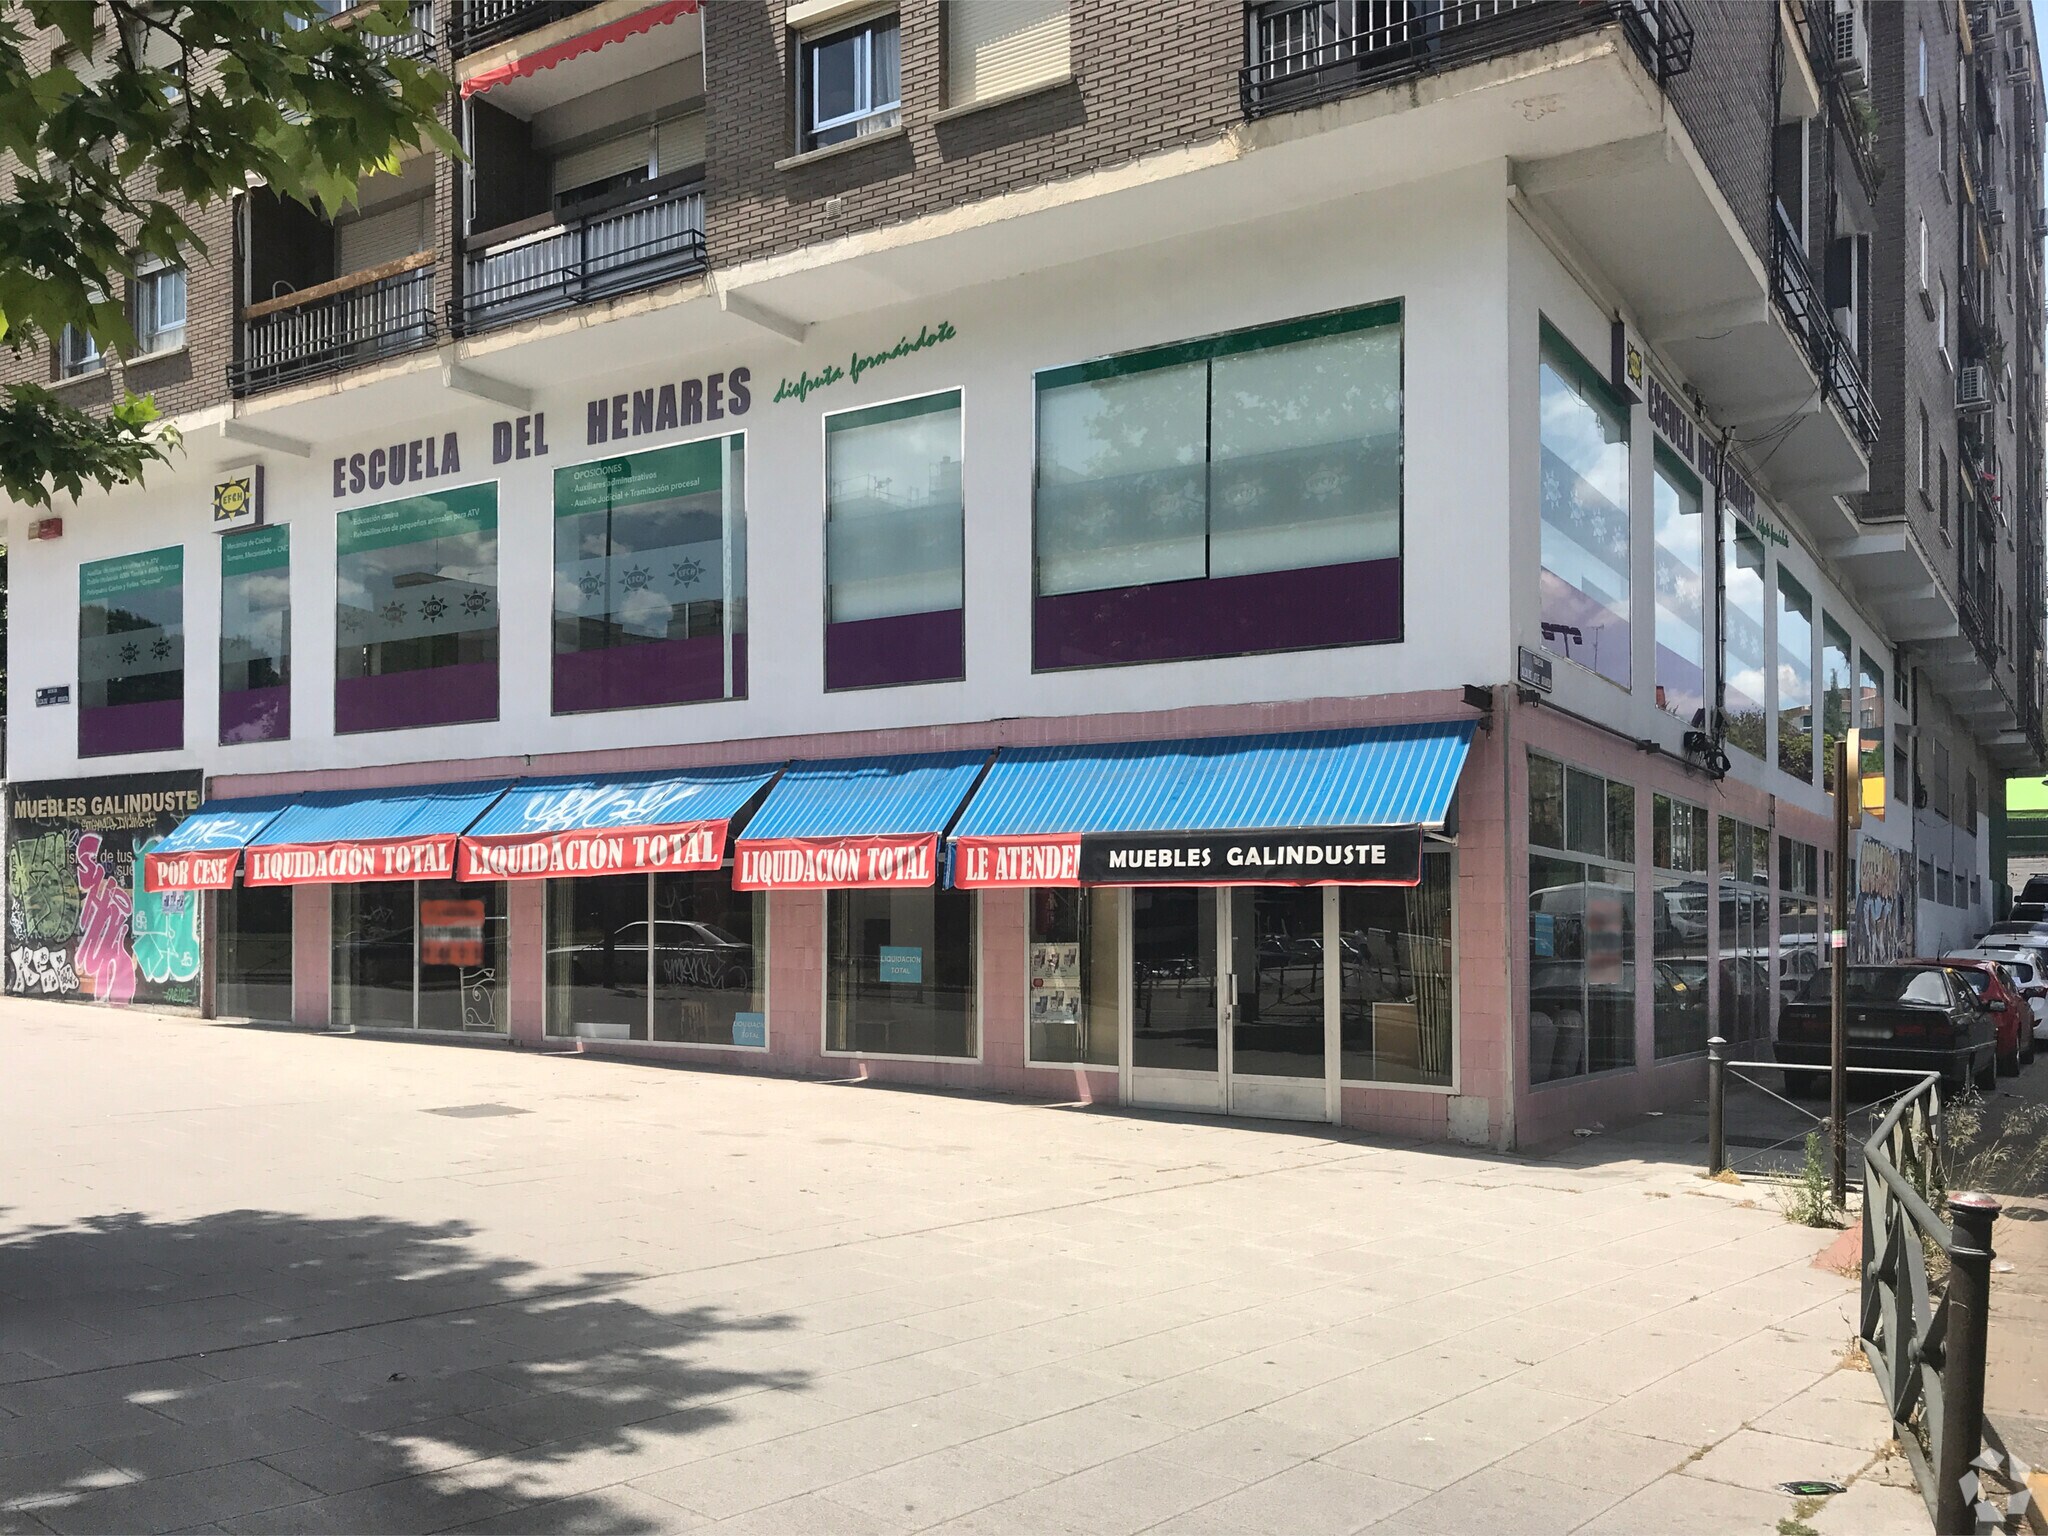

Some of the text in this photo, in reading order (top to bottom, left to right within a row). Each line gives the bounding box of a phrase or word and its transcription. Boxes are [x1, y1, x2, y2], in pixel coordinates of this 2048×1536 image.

[773, 320, 957, 403] disfruta formándote
[333, 366, 752, 498] ESCUELA DEL HENARES
[1648, 374, 1695, 465] ESCUELA
[574, 464, 622, 480] OPOSICIONES
[222, 491, 244, 506] EFCH
[574, 496, 597, 508] Auxilio
[630, 484, 670, 499] Tramitación
[670, 477, 699, 492] procesal
[467, 507, 481, 518] ATV
[14, 790, 198, 819] MUEBLES GALINDUSTE
[100, 849, 114, 863] de
[117, 849, 133, 863] tus
[252, 840, 450, 881] LIQUIDACIÓN TOTAL
[468, 830, 718, 877] LIQUIDACIÓN TOTAL
[740, 841, 930, 886] LIQUIDACIÓN TOTAL
[965, 847, 989, 881] LE
[1108, 844, 1386, 868] MUEBLES GALINDUSTE
[157, 858, 228, 886] POR CESE
